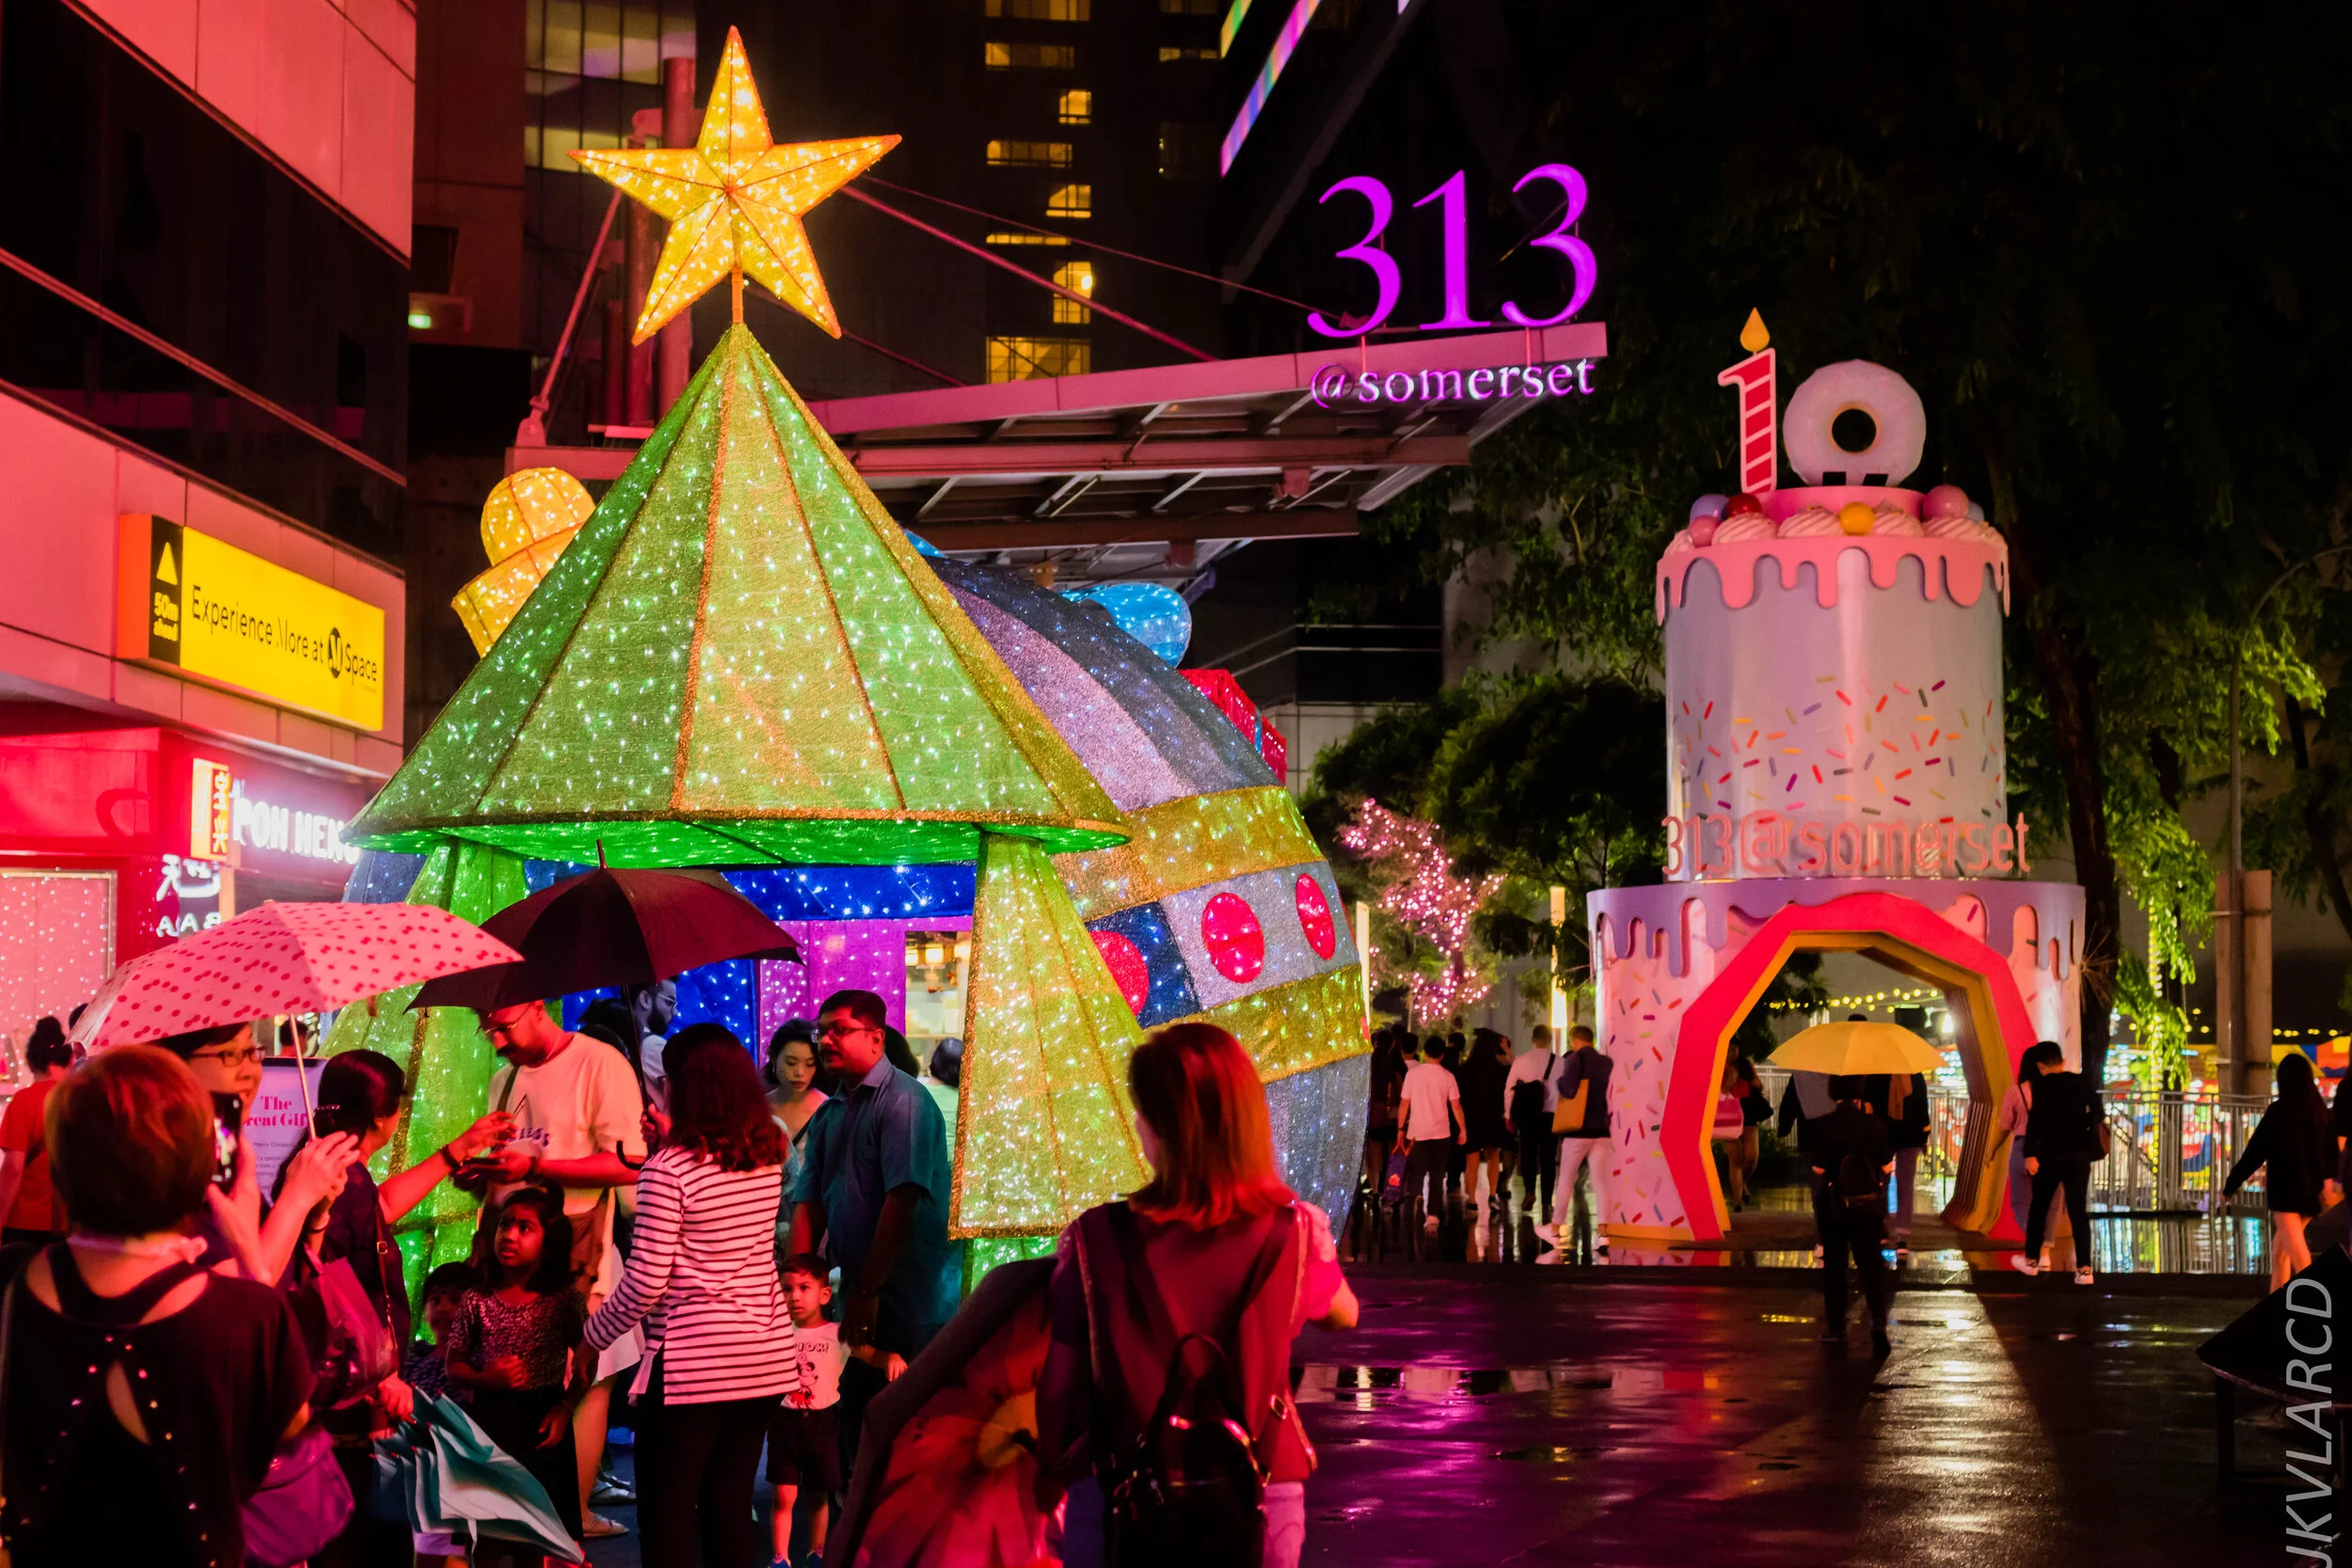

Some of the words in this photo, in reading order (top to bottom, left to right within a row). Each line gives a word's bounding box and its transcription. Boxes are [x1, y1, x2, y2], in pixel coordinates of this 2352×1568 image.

[1308, 163, 1597, 338] 313
[1310, 357, 1596, 409] @somerset
[1718, 347, 1927, 495] 10
[192, 584, 273, 645] Experience
[311, 636, 324, 664] at
[344, 642, 377, 686] Space
[1661, 810, 2031, 876] 313@somerset
[244, 1116, 277, 1127] reat
[279, 1113, 308, 1127] Gif
[260, 1096, 293, 1110] The
